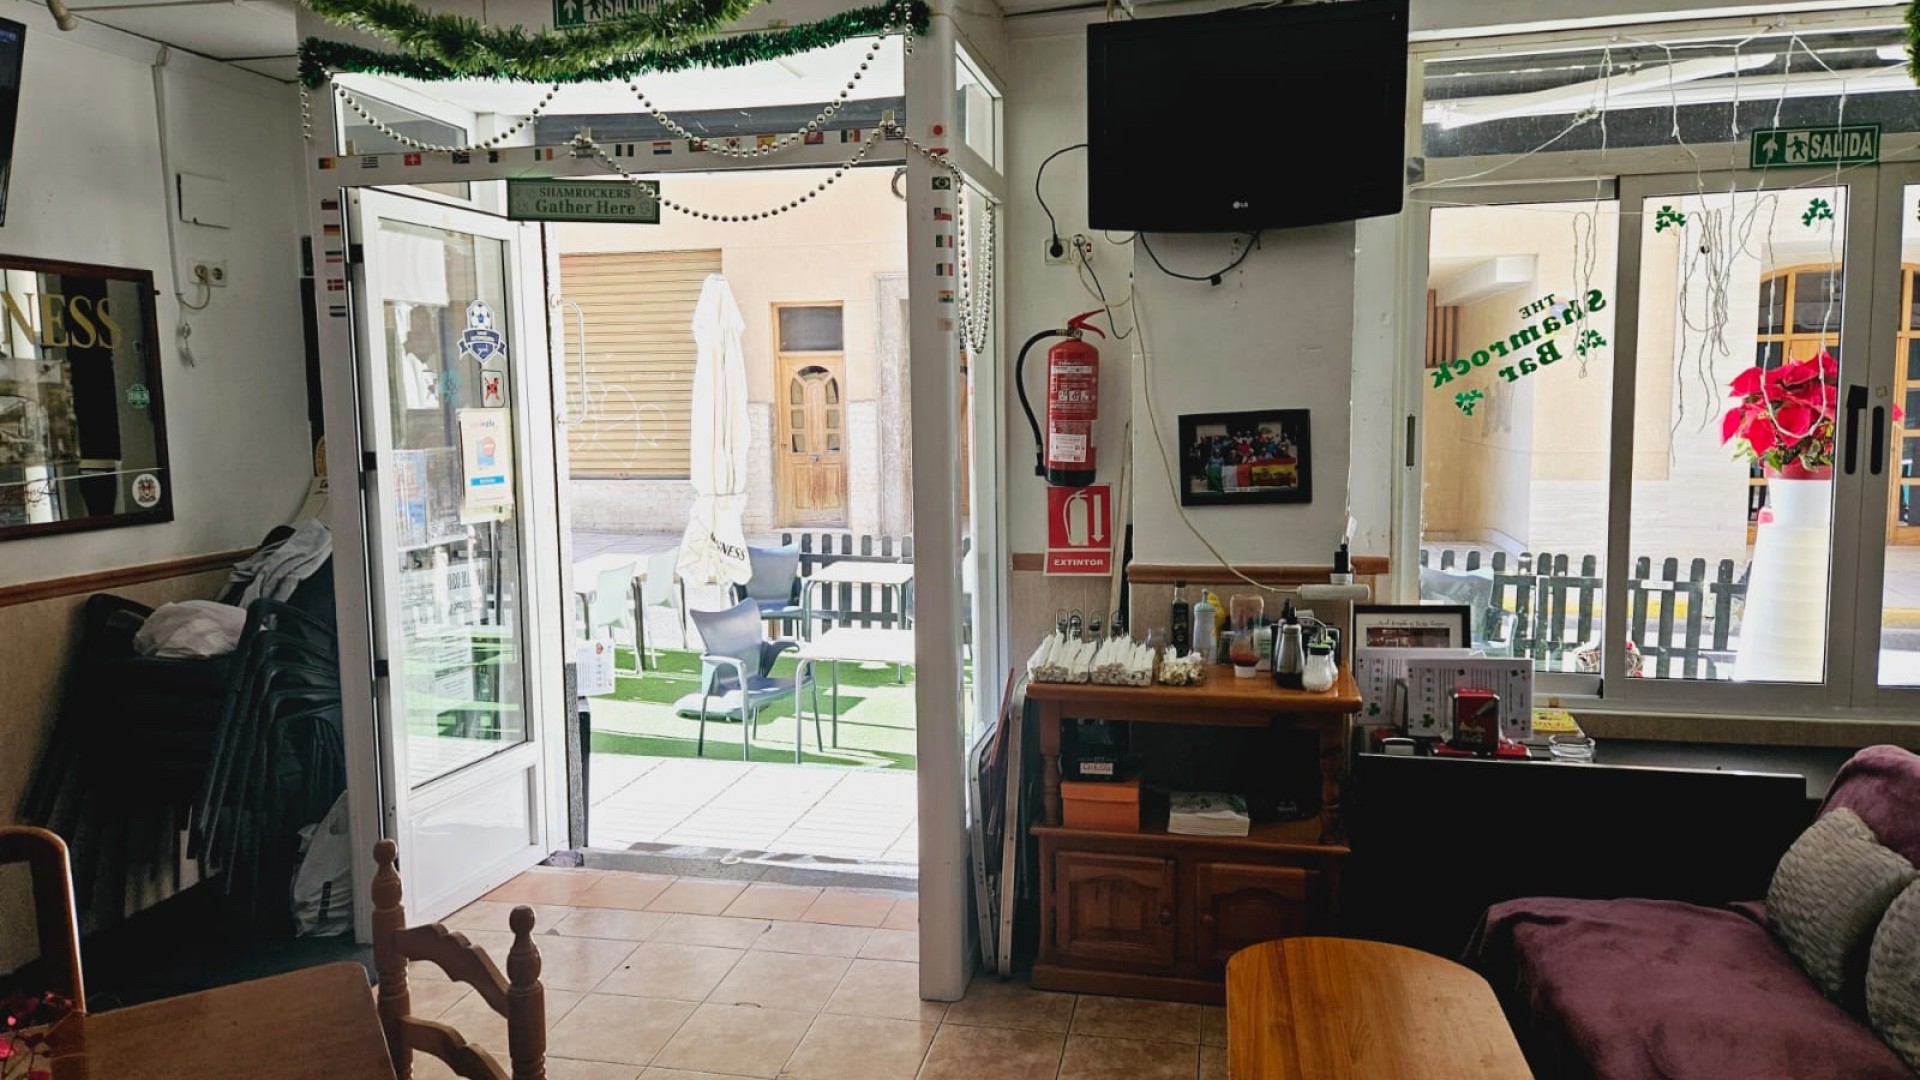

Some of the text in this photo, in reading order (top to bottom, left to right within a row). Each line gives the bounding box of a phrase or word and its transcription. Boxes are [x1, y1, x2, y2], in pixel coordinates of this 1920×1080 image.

[1810, 132, 1873, 159] SALIDA
[539, 187, 631, 199] SHAMROCKERS
[535, 199, 636, 215] Gather Here
[713, 534, 746, 561] NESS
